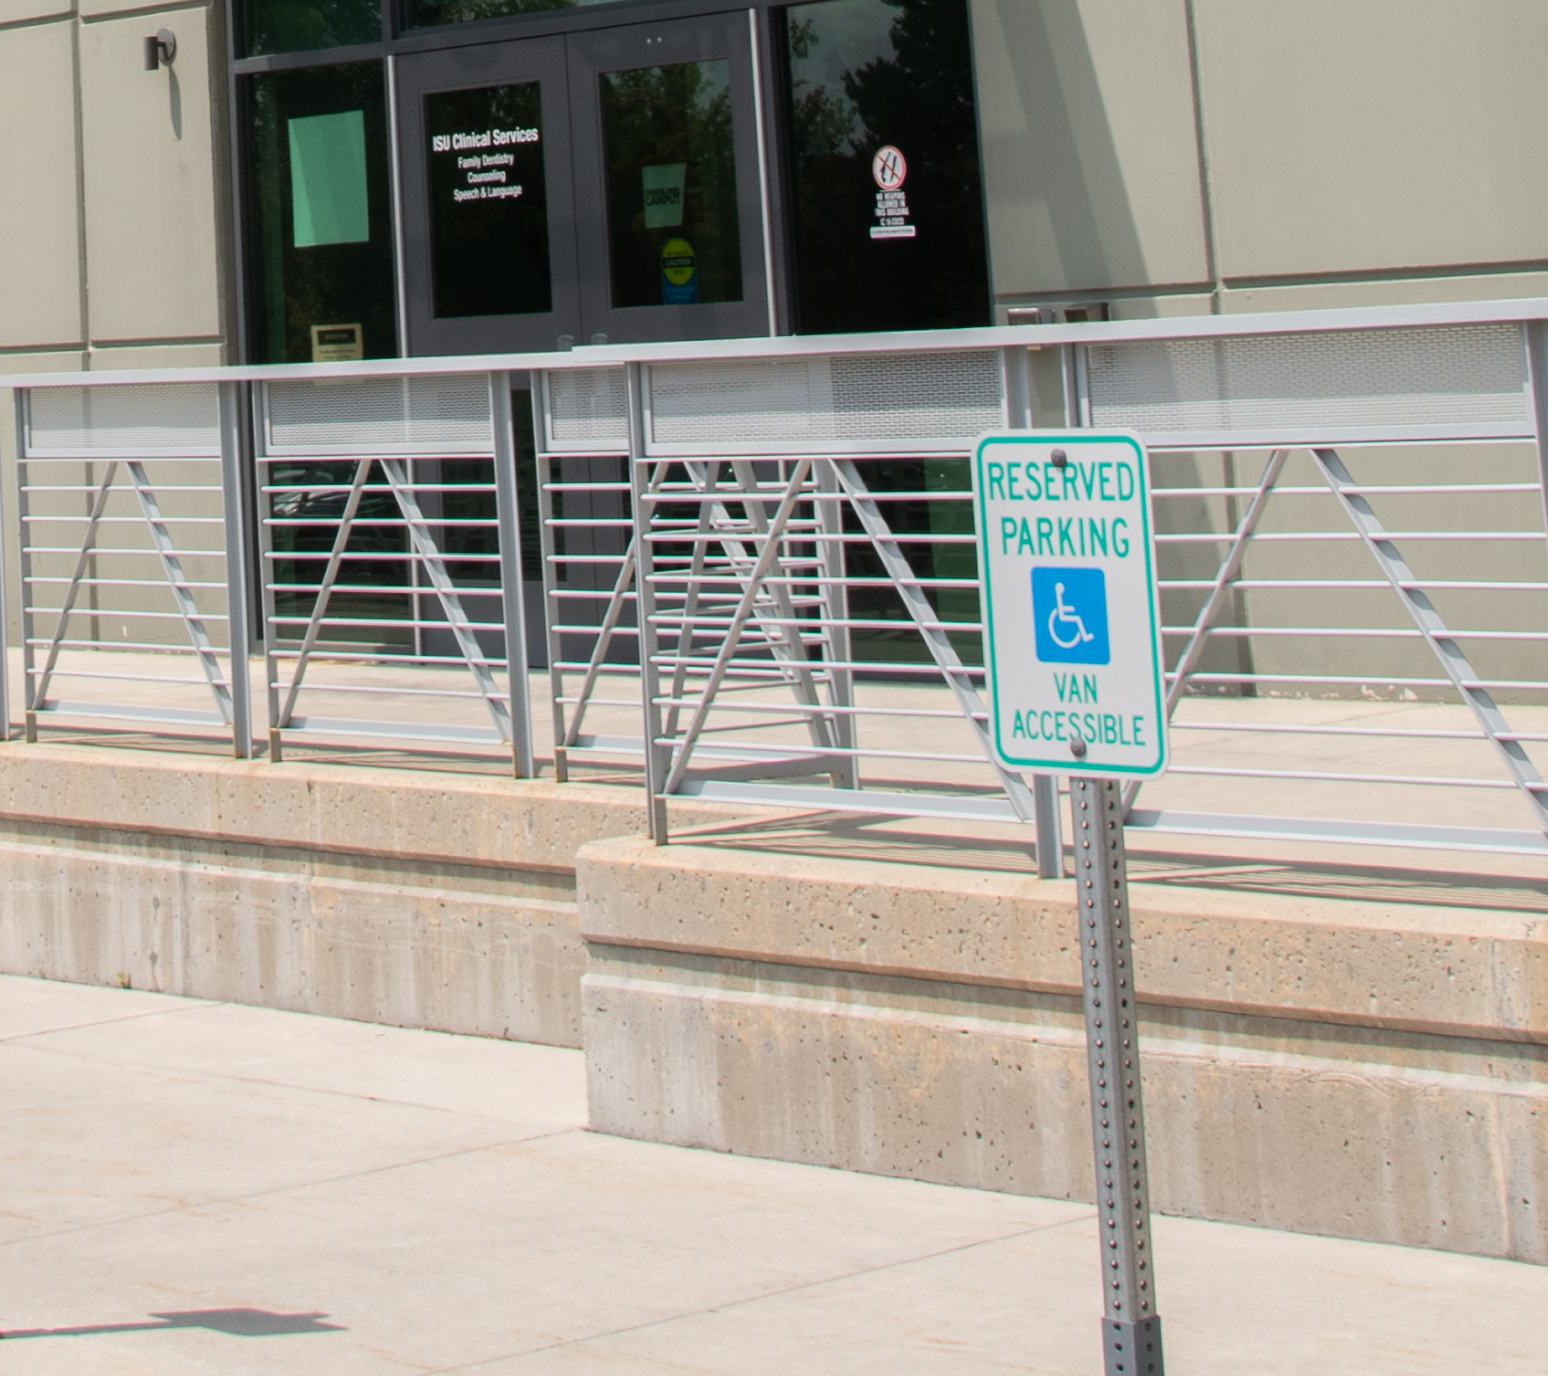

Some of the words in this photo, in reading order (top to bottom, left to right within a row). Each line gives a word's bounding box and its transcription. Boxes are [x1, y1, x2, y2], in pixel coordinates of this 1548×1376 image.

[432, 134, 451, 151] ISU
[452, 130, 491, 150] Clinical
[492, 127, 539, 145] Services
[457, 155, 481, 169] Family
[482, 152, 514, 166] Dentistry
[467, 169, 506, 183] Counseling
[453, 188, 479, 202] Speech
[480, 186, 487, 199] &
[487, 185, 522, 199] Language
[987, 461, 1135, 502] RESERVED
[1000, 515, 1130, 559] PARKING
[1053, 672, 1099, 705] VAN
[1012, 708, 1147, 747] ACCESSIBLE
